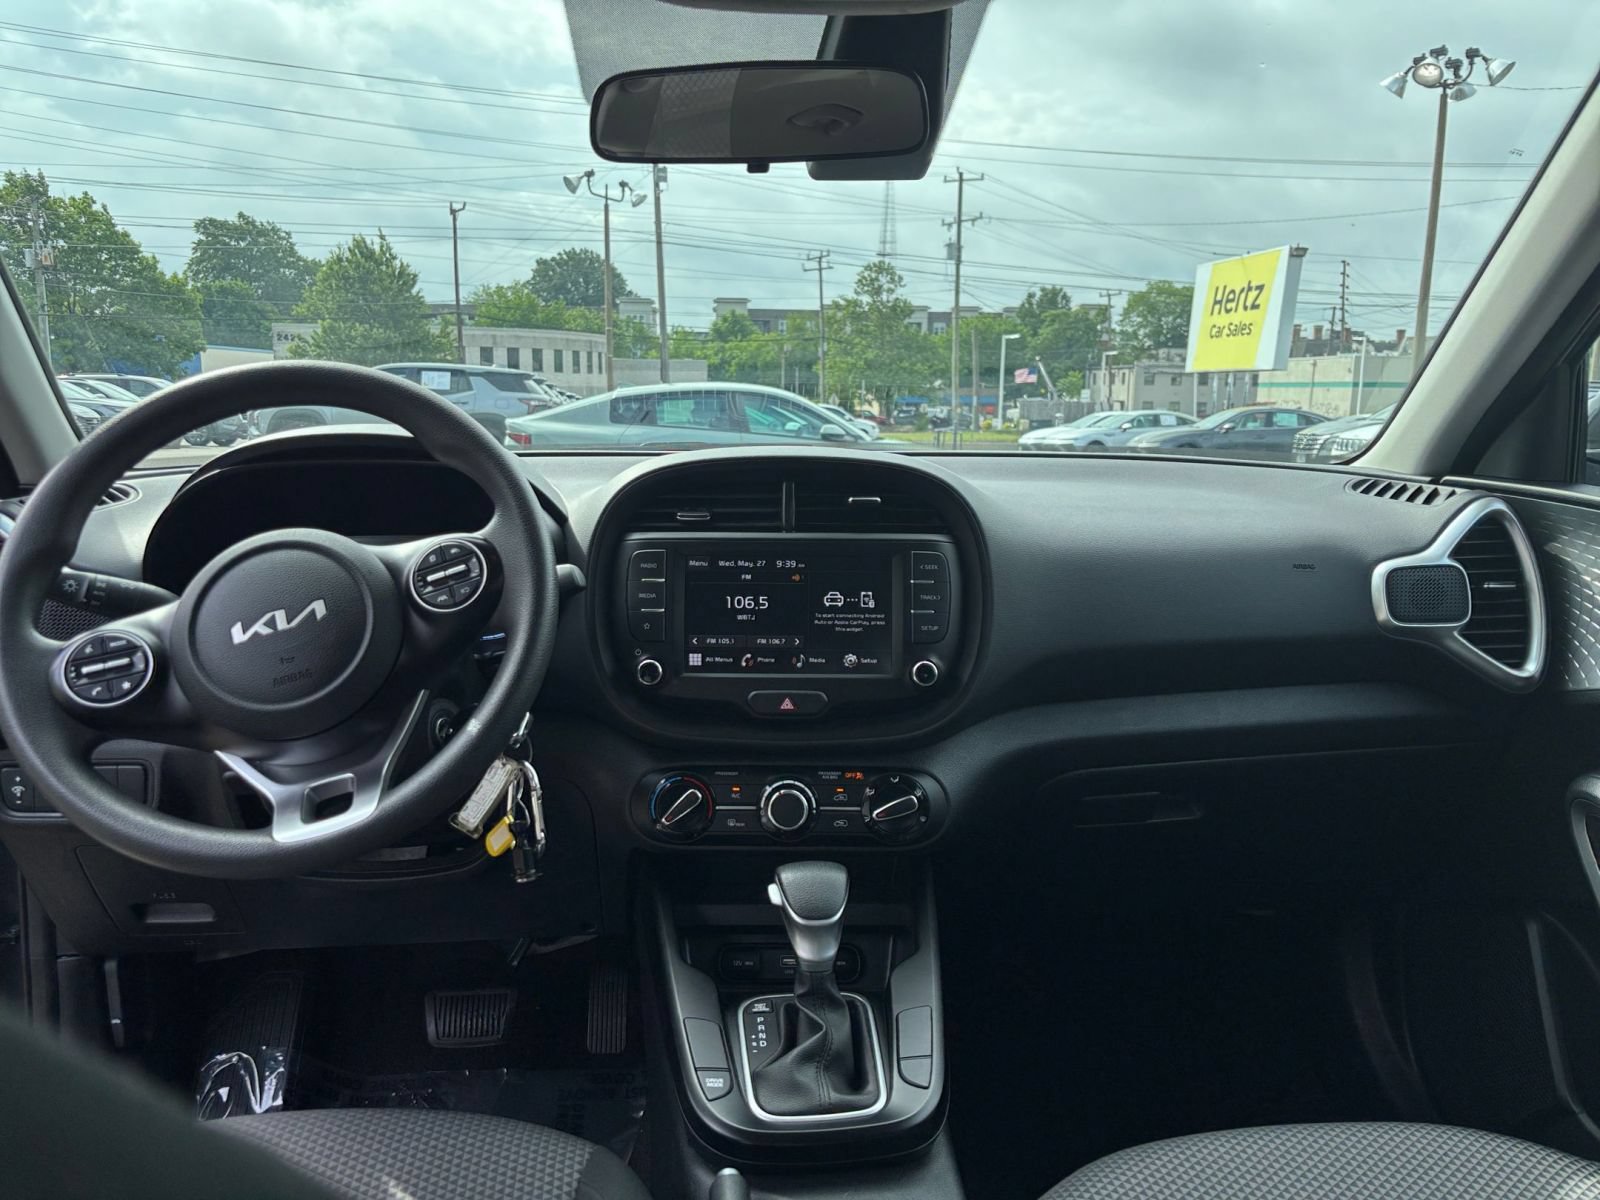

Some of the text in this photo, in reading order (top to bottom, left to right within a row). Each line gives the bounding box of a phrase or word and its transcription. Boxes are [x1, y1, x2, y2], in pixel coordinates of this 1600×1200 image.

[1210, 280, 1265, 316] Hertz
[1209, 321, 1254, 339] Car Sales
[776, 560, 797, 568] 9:39
[725, 596, 769, 610] 106.5
